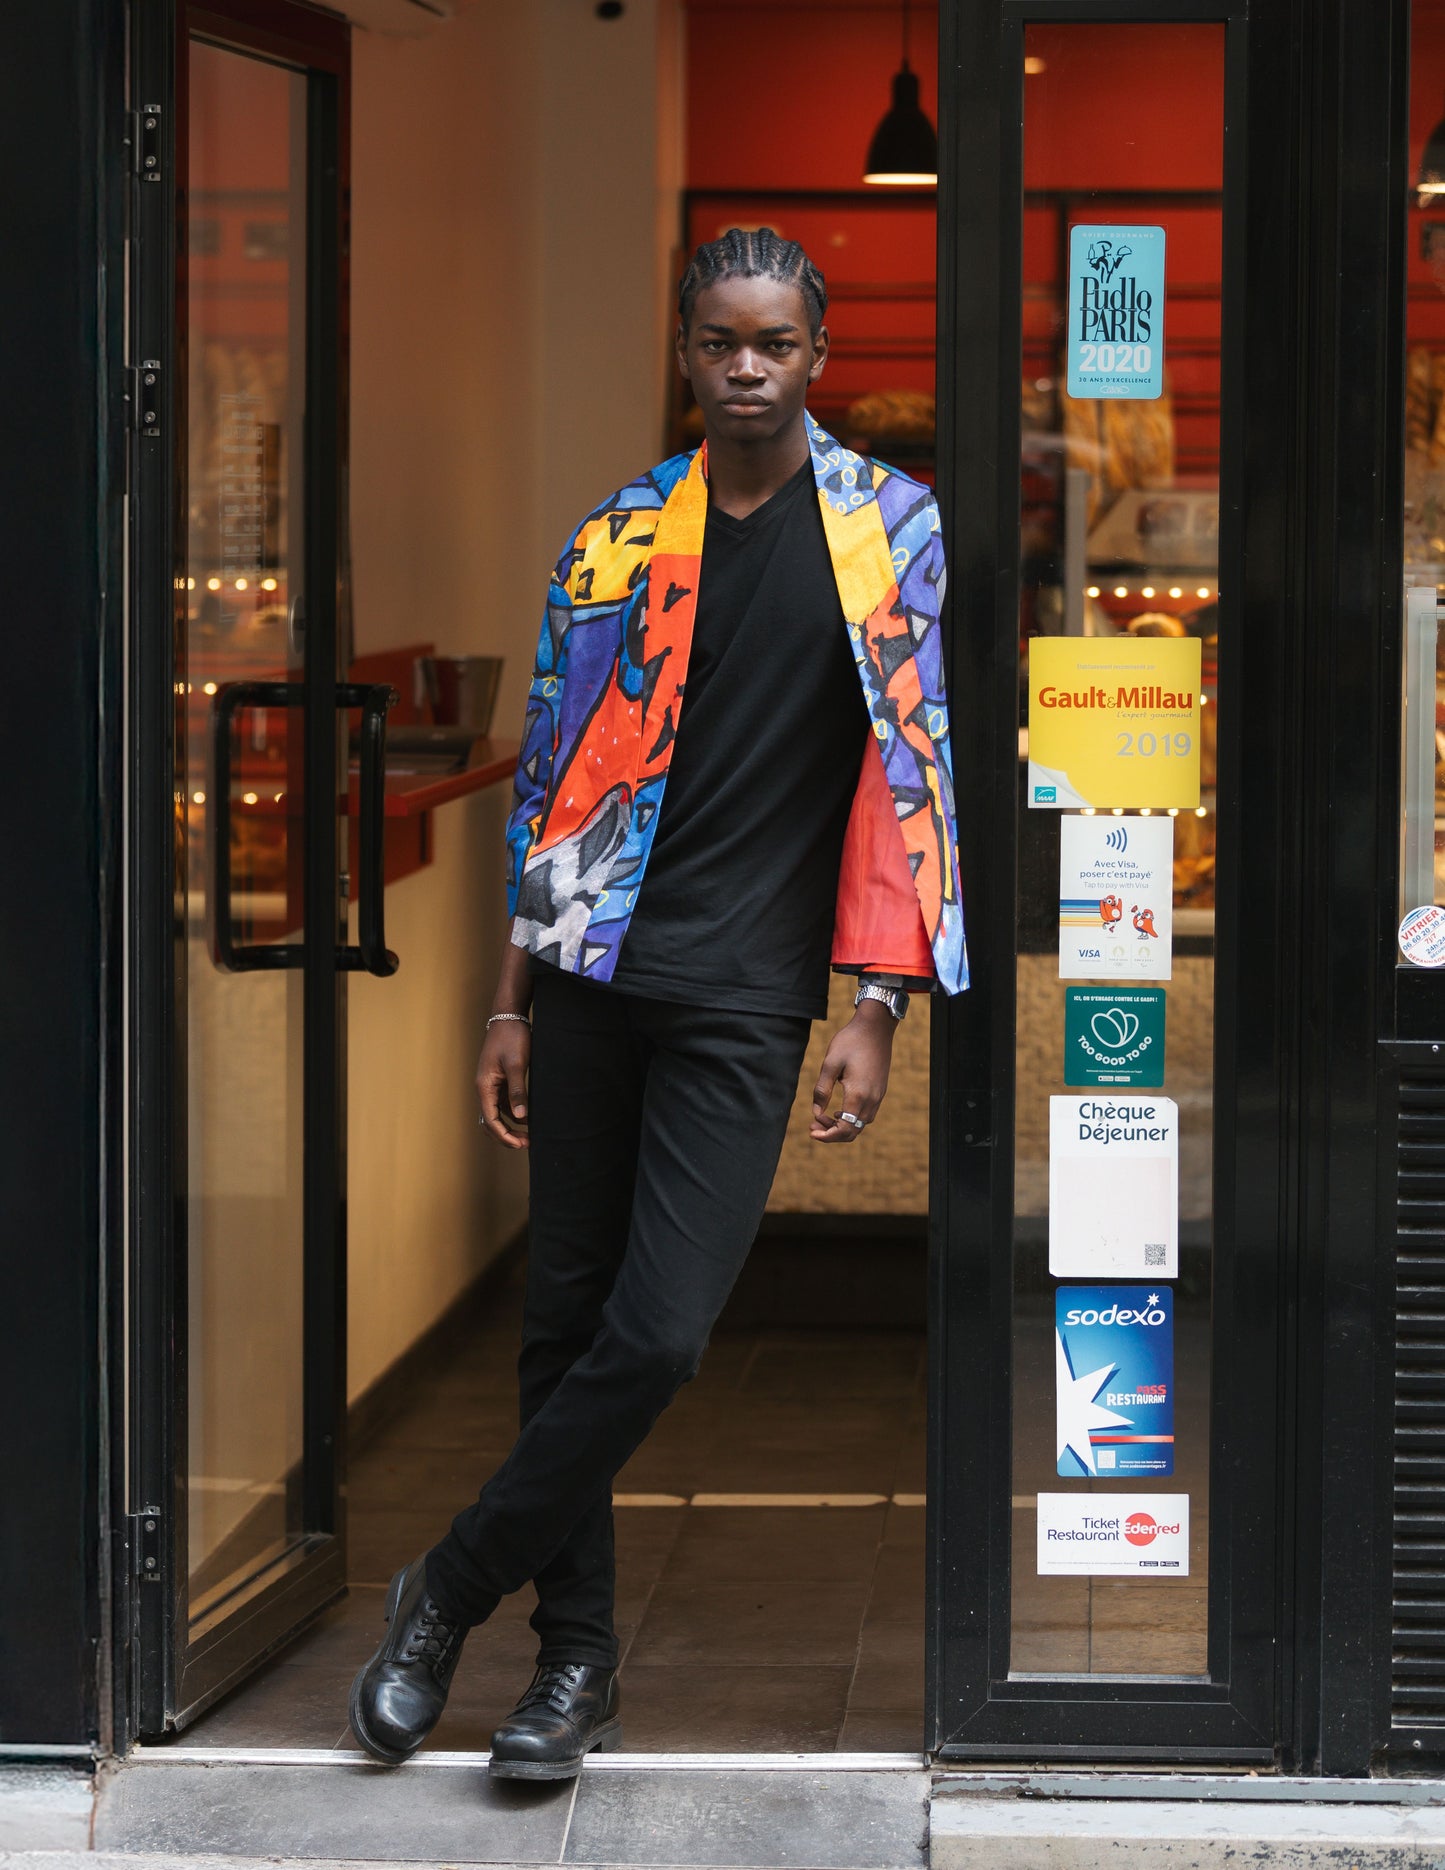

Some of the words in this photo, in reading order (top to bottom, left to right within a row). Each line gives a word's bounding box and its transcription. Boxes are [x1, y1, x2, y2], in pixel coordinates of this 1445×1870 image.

[1080, 277, 1152, 311] Pudlo
[1078, 308, 1151, 343] PARIS
[1079, 344, 1151, 373] 2020
[1150, 711, 1192, 720] gourmand
[1116, 732, 1191, 757] 2019
[1080, 871, 1105, 879] poser
[1094, 860, 1116, 868] Avec
[1117, 861, 1138, 869] Visa,
[1401, 909, 1439, 941] VITRIER
[1078, 949, 1100, 958] VISA
[1078, 1035, 1095, 1055] TOO
[1095, 1052, 1126, 1065] GOOD
[1126, 1049, 1140, 1061] TO
[1138, 1036, 1152, 1051] GO
[1079, 1102, 1156, 1123] Chèque
[1079, 1123, 1169, 1145] Déjeuner
[1064, 1303, 1166, 1326] sodexo
[1106, 1393, 1166, 1406] RESTAURANT
[1081, 1517, 1119, 1529] Ticket
[1124, 1522, 1180, 1534] Edenred
[1047, 1529, 1120, 1541] Restaurant
